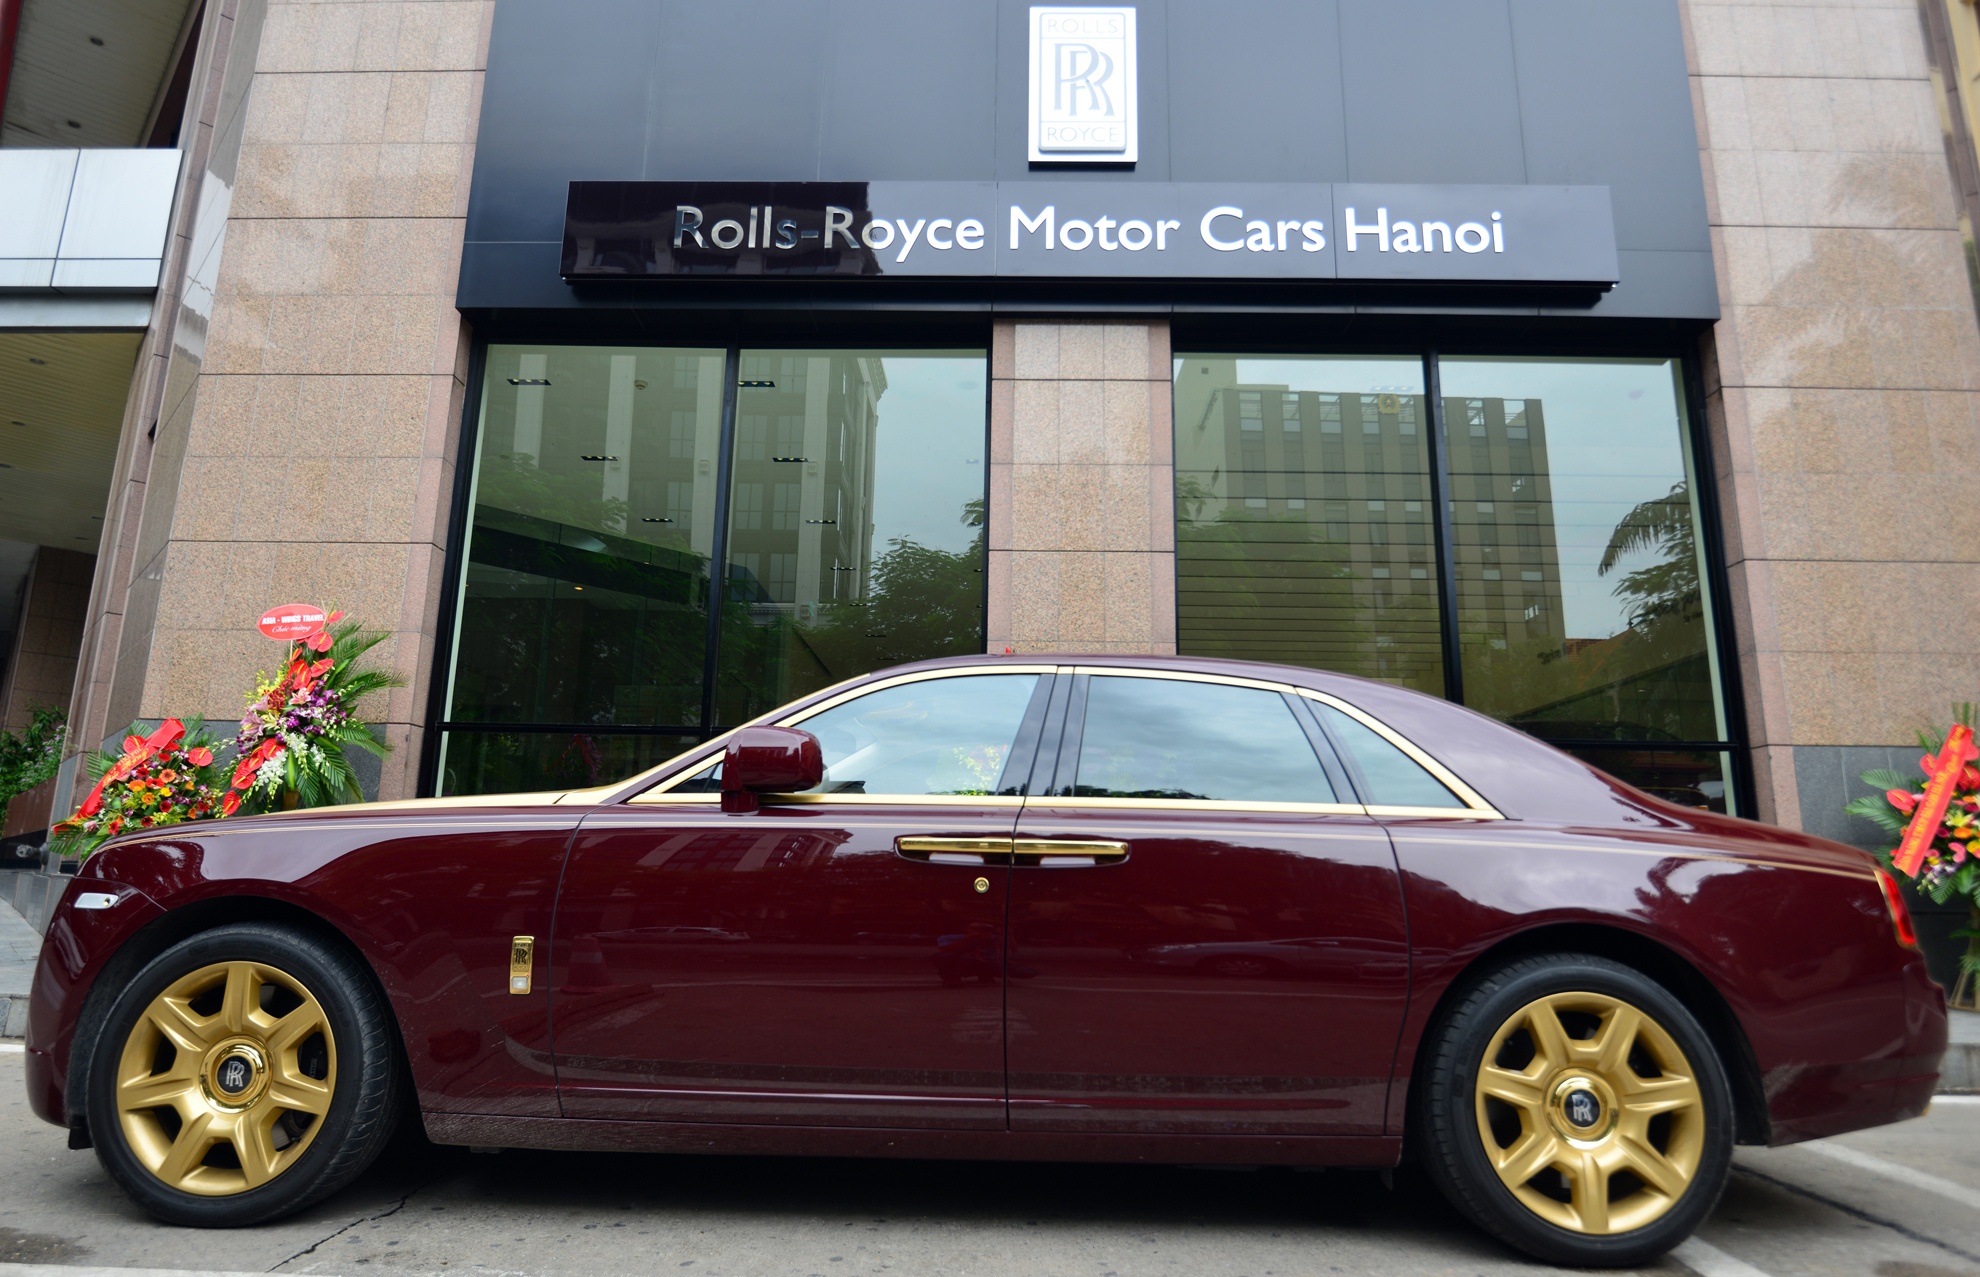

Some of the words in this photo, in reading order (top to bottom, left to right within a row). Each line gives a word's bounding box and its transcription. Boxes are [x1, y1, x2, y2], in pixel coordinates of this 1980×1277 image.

[1048, 19, 1118, 34] ROLLS
[1047, 127, 1118, 142] ROYCE
[673, 205, 985, 263] Rolls-Royce
[1009, 205, 1181, 251] Motor
[1200, 206, 1326, 252] Cars
[1344, 207, 1505, 254] Hanoi
[303, 614, 324, 622] TRAVEL
